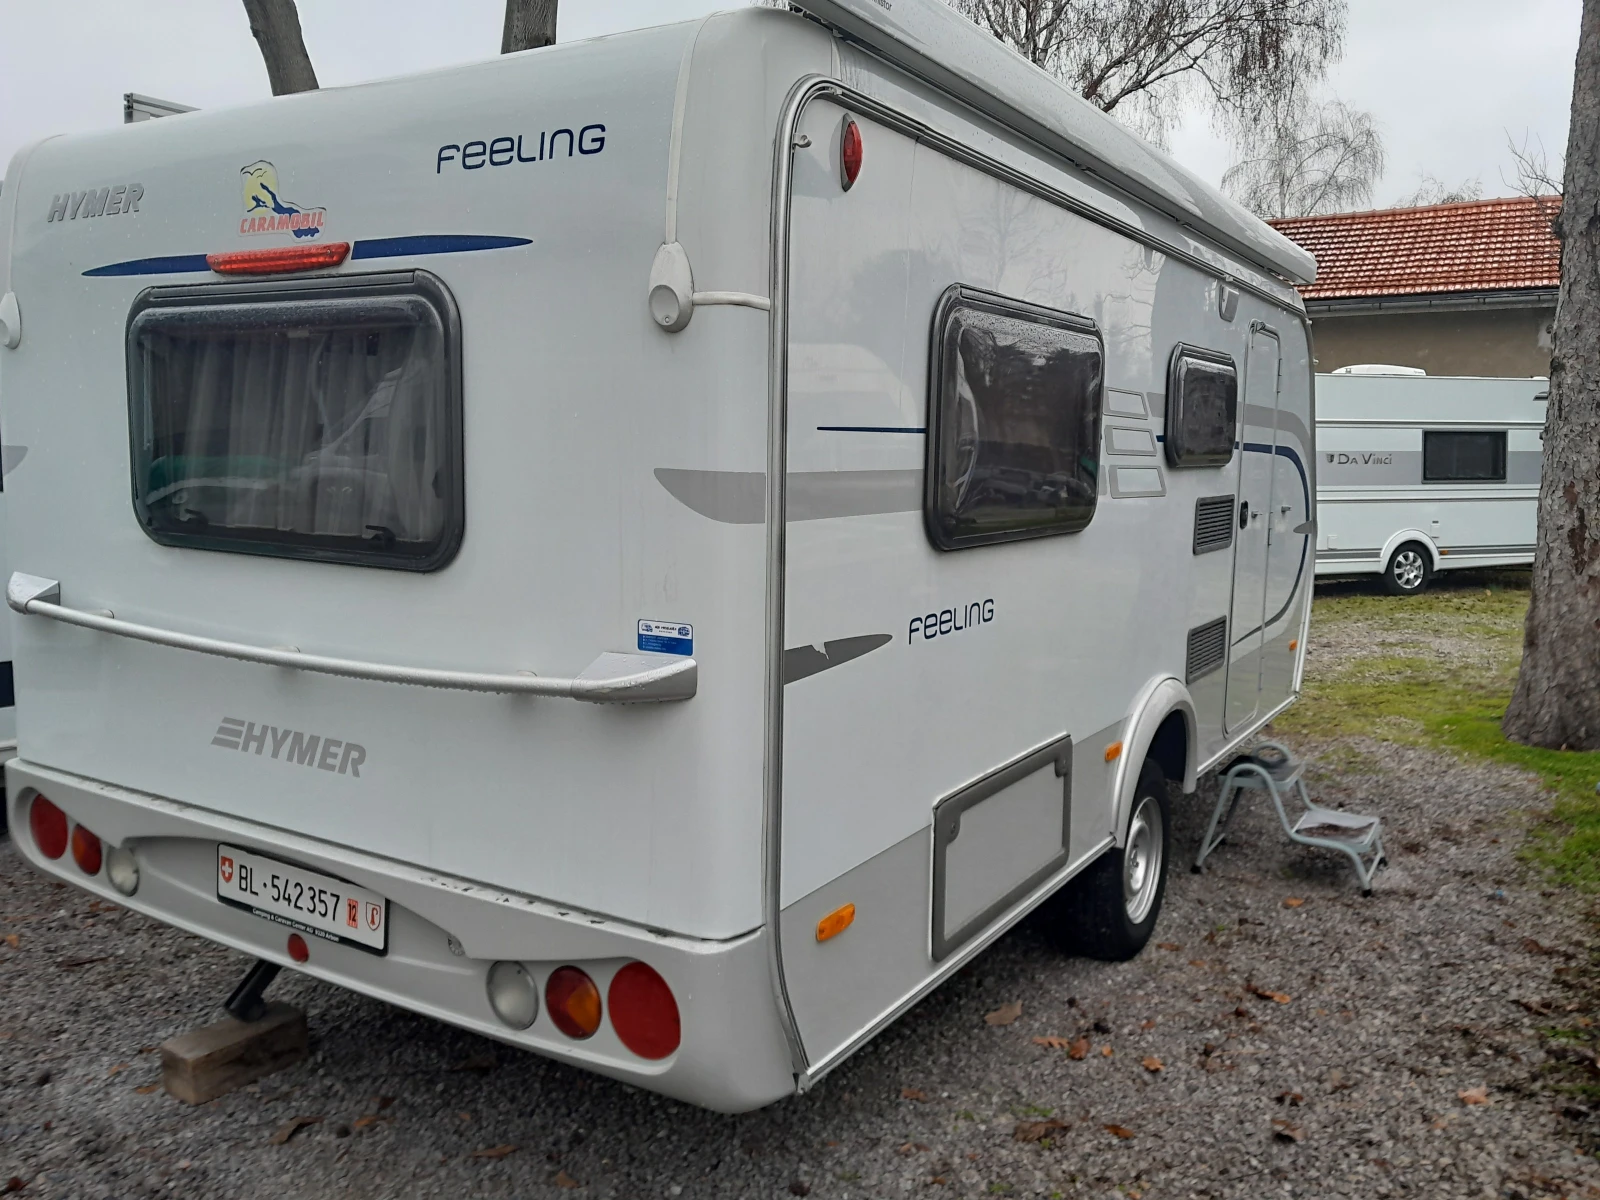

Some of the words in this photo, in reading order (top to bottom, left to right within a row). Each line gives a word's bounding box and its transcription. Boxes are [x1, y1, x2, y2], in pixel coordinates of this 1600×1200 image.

[47, 182, 145, 223] HYMER
[240, 211, 324, 234] CARAMOBIL
[252, 908, 271, 921] Camping
[348, 903, 357, 922] 12
